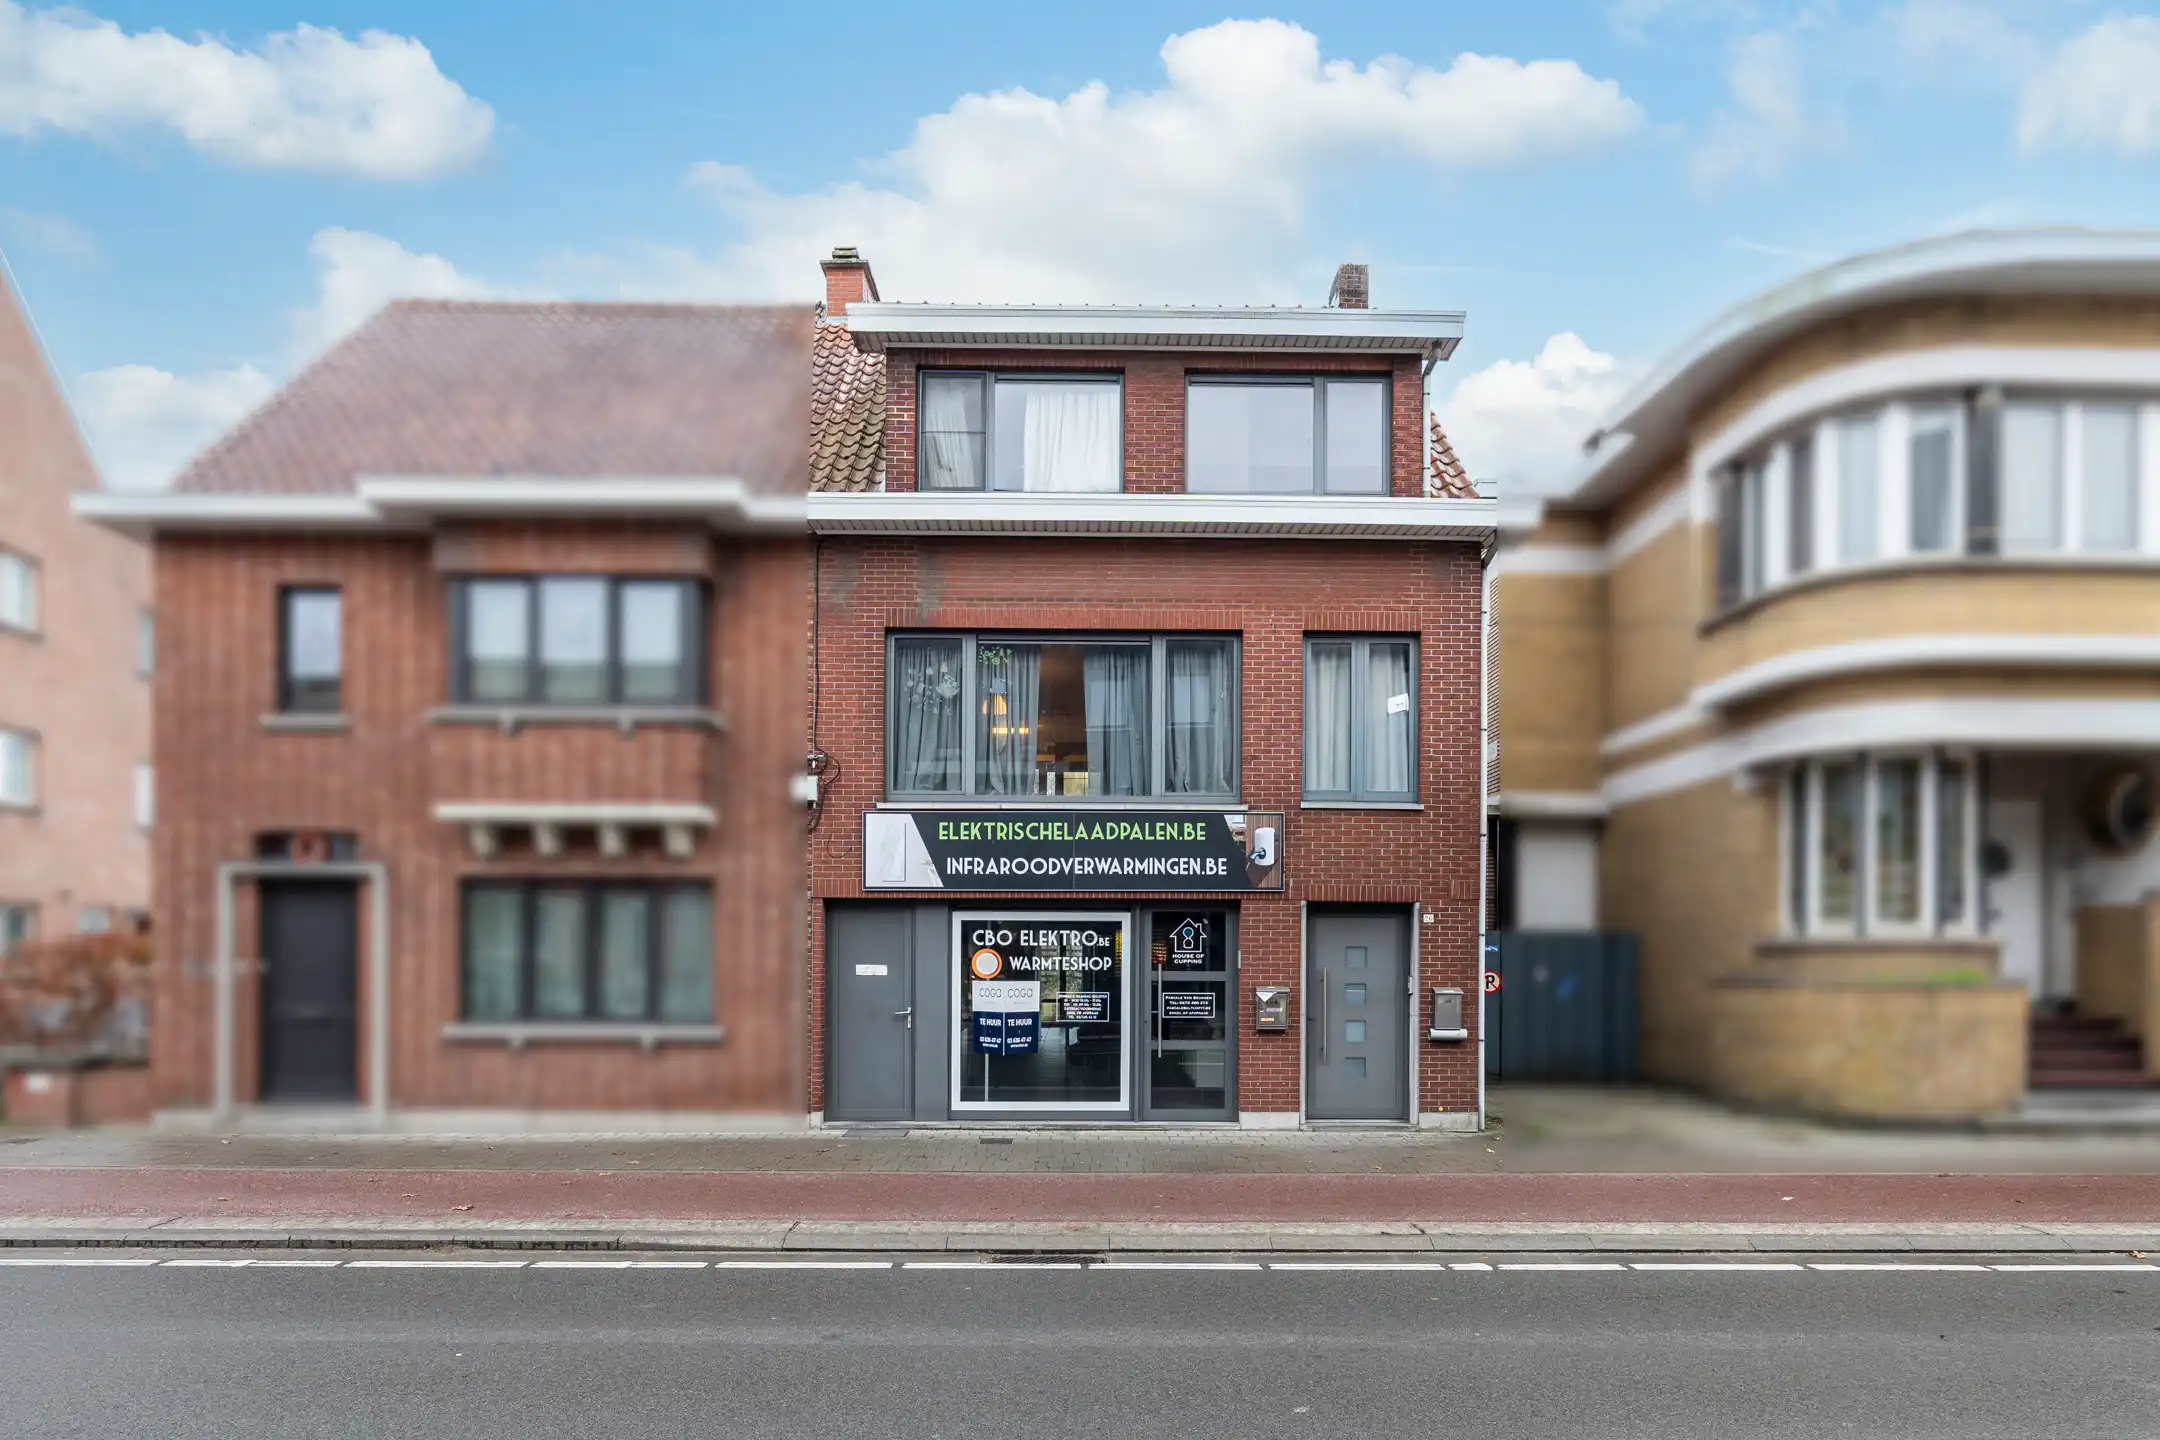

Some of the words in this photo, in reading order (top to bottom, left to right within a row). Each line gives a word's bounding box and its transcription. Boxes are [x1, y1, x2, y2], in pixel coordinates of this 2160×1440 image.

[938, 821, 1206, 841] ELEKTRISCHELAADPALEN.BE
[946, 857, 1228, 875] INFRAROODVERWARMINGEN.BE
[972, 930, 1013, 946] CBO
[1009, 956, 1113, 971] WARMTESHOP
[979, 1018, 986, 1026] TE
[986, 1018, 1002, 1026] HUUR
[1015, 1018, 1033, 1026] HUUR
